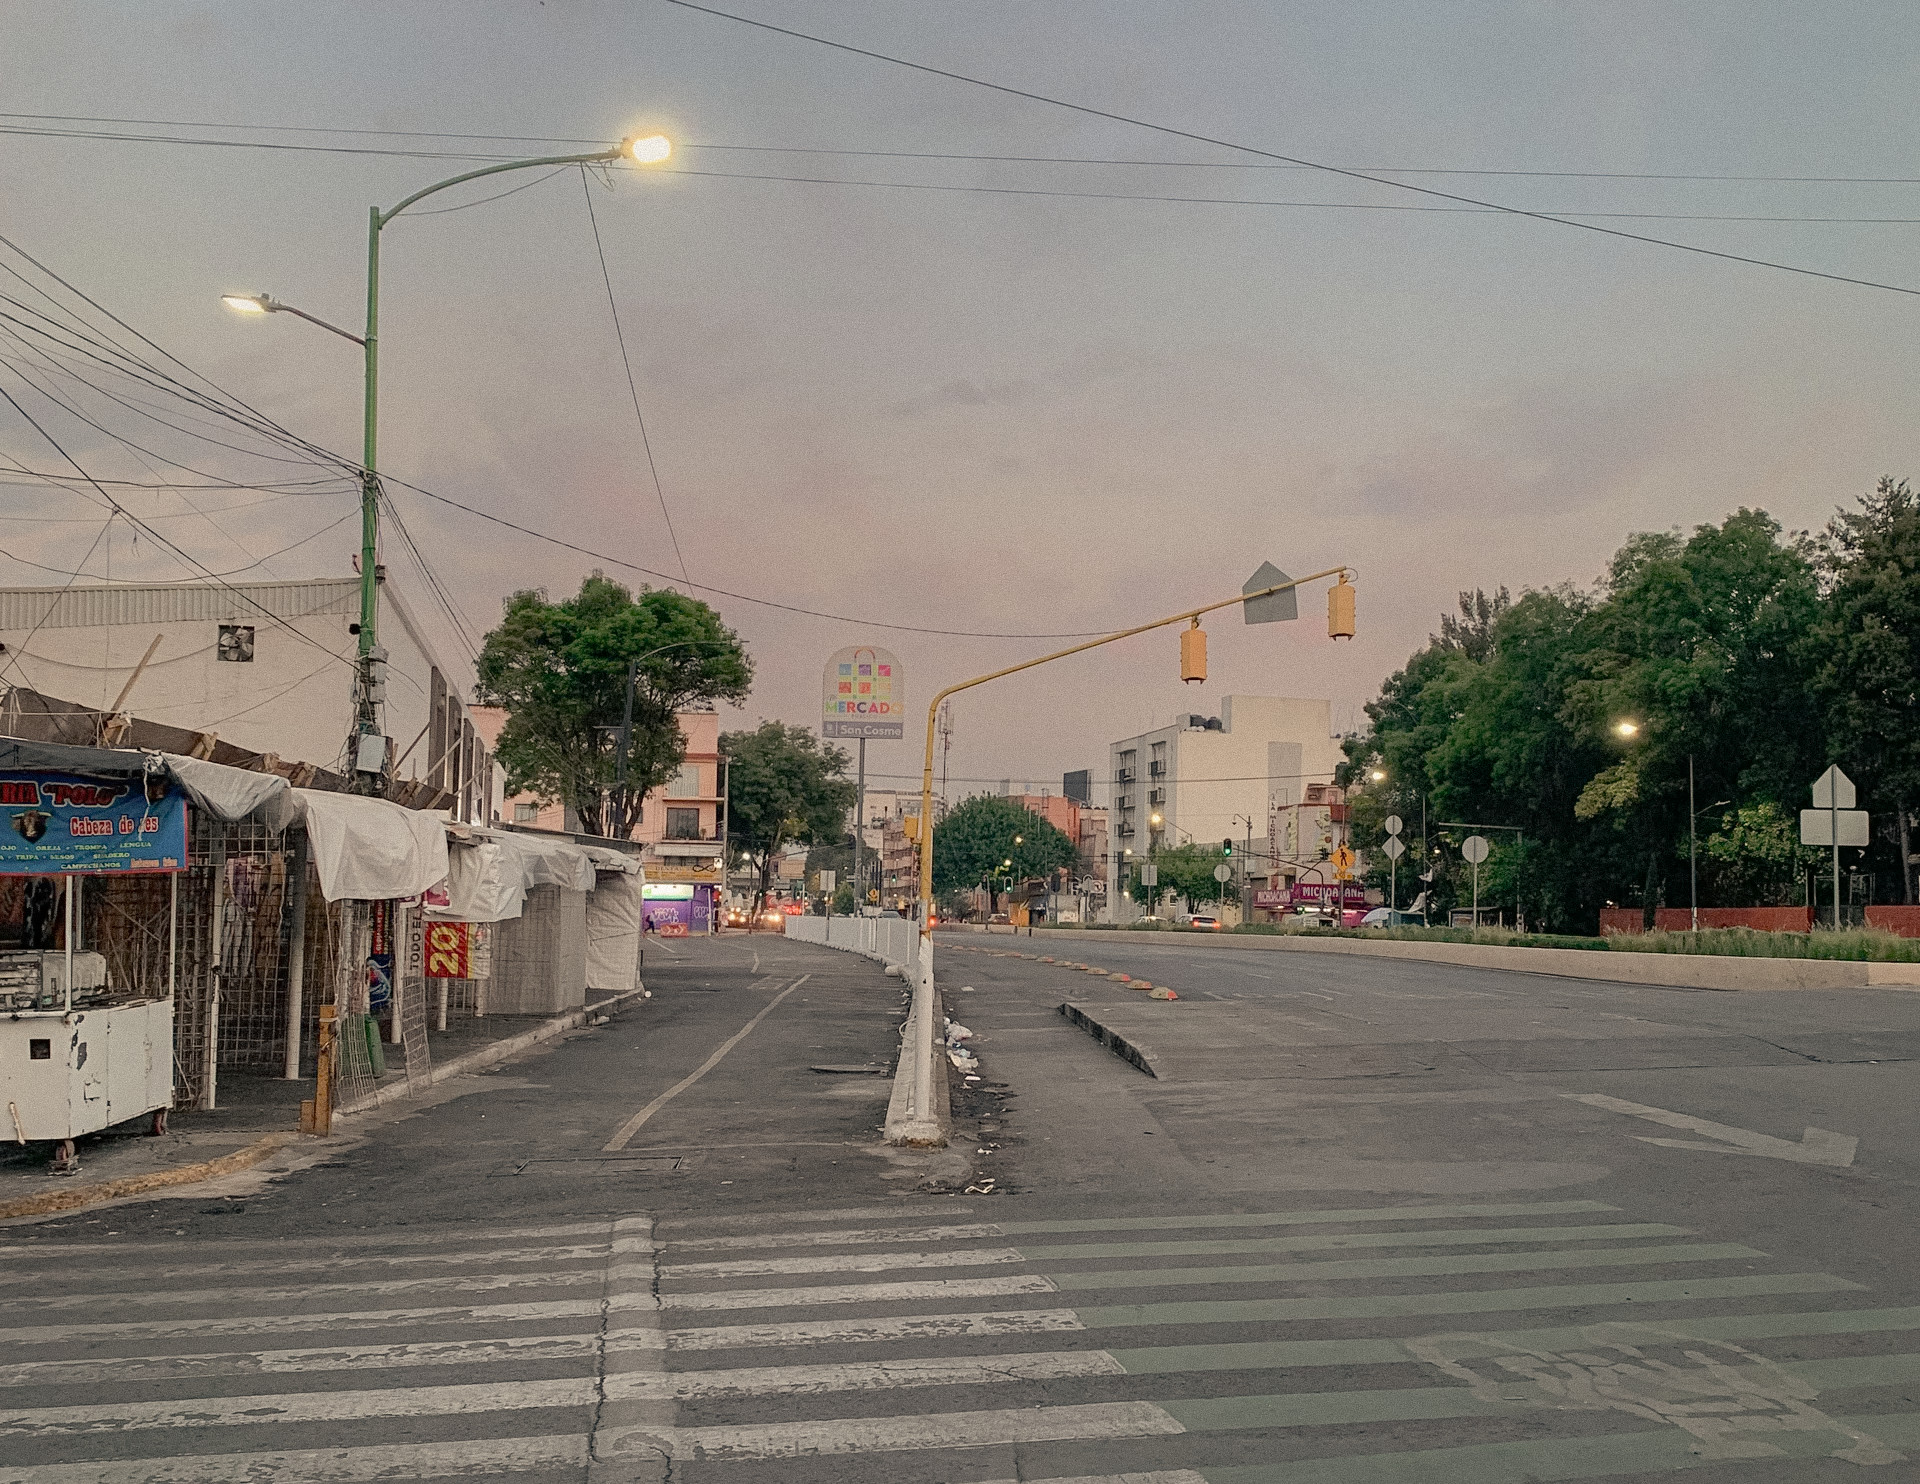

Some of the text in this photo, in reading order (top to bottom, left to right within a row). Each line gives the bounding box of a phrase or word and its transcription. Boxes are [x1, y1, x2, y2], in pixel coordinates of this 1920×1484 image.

[825, 701, 904, 714] MERCADO
[840, 725, 902, 736] San Cosme
[70, 816, 113, 836] Cabeza
[119, 815, 134, 835] de
[1302, 886, 1364, 898] MICHOAANA
[409, 932, 421, 971] TODO
[430, 926, 460, 975] 20
